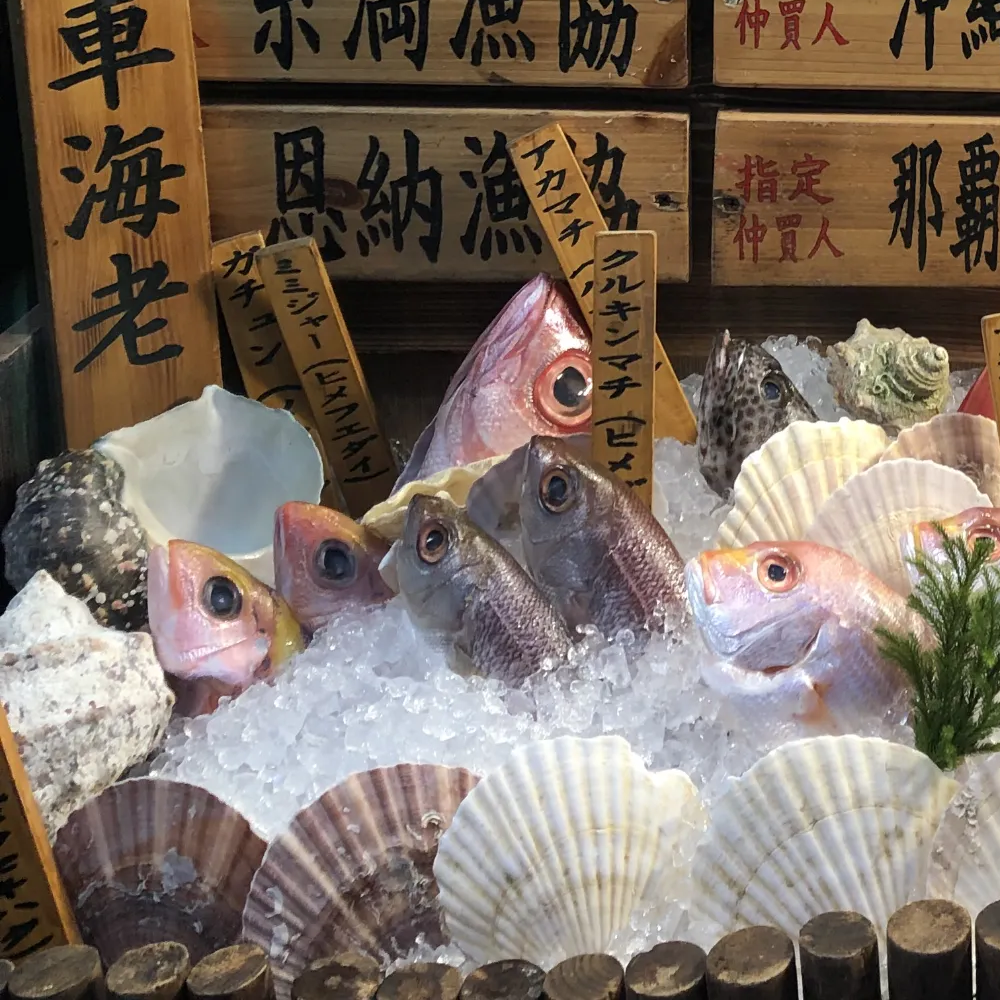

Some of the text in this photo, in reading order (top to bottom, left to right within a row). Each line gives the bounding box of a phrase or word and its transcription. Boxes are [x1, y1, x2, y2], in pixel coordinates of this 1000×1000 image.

[734, 153, 835, 206] 指定
[732, 214, 846, 265] 仲買人
